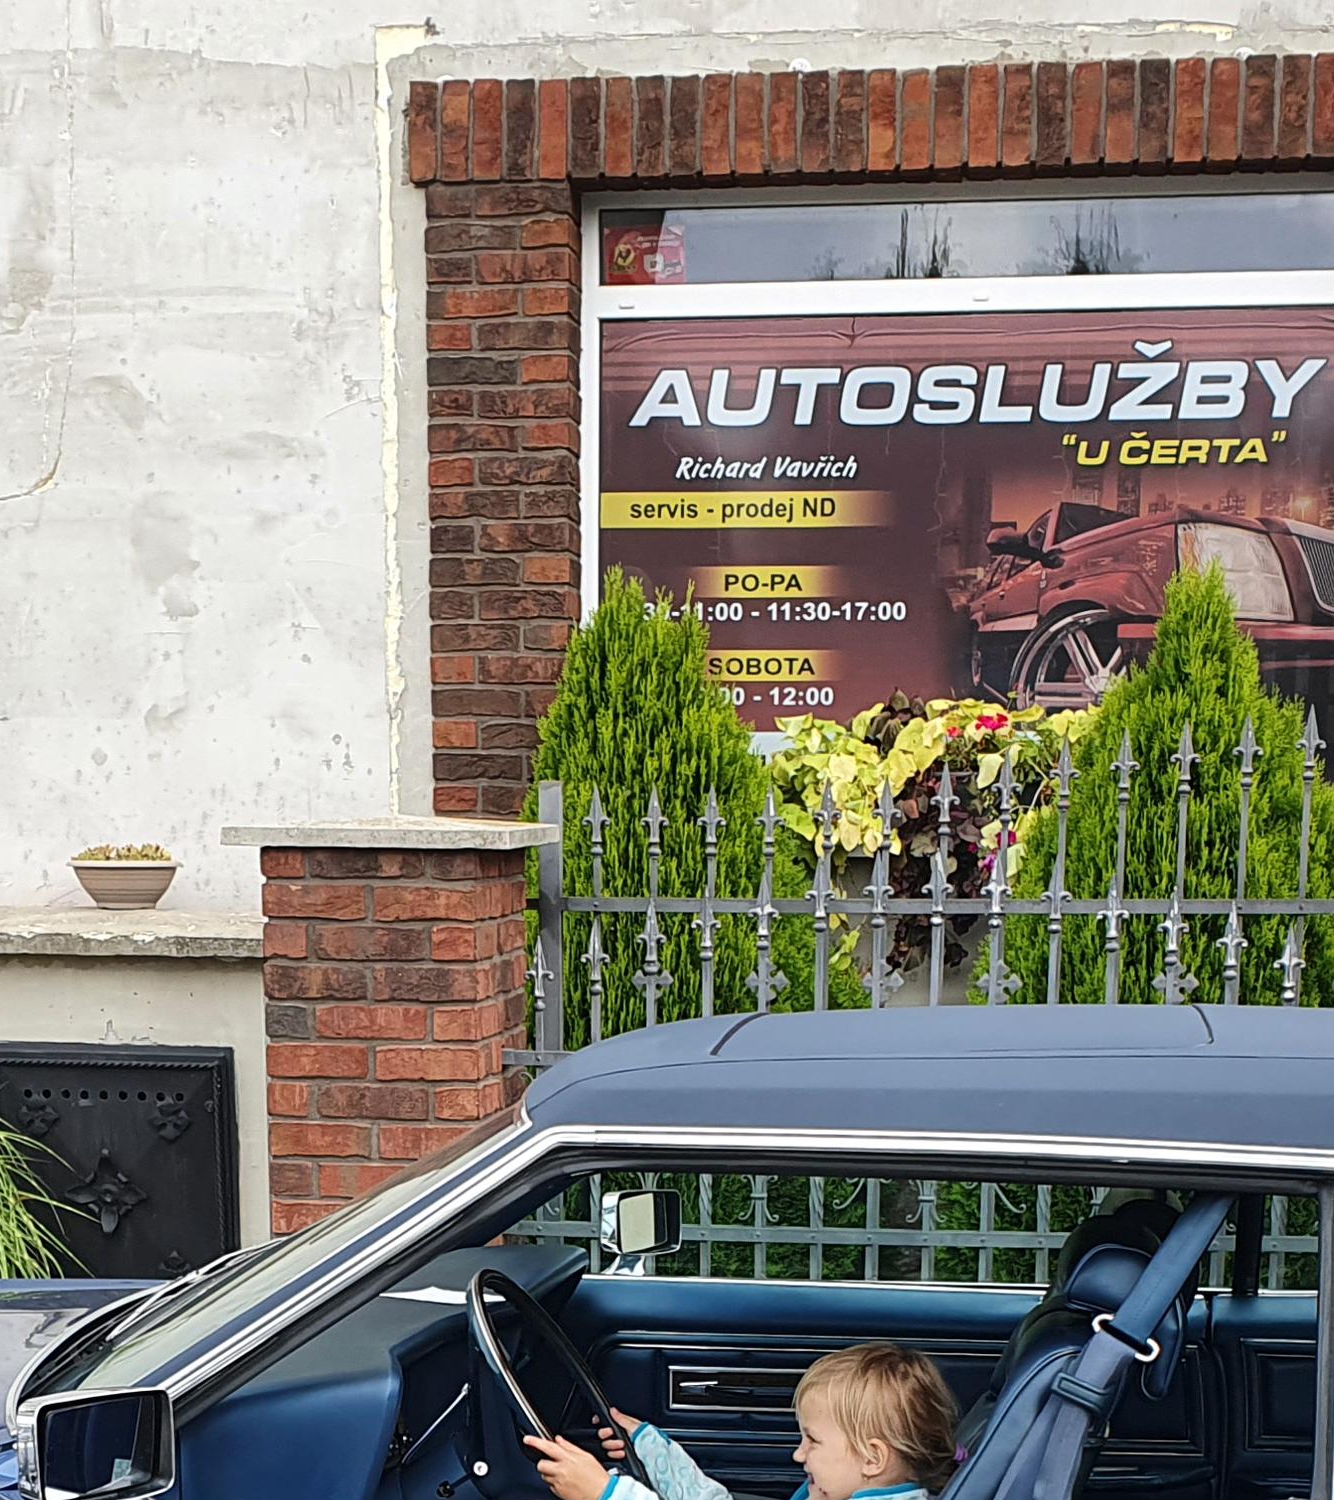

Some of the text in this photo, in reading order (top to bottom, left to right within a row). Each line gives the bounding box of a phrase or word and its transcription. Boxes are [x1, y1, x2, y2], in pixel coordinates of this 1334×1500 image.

[628, 340, 1328, 427] AUTOSLUŽBY
[675, 455, 858, 480] Richard Vavřich
[630, 499, 698, 519] servis
[721, 498, 794, 523] prodej
[802, 497, 836, 518] ND
[724, 573, 803, 592] PO-PA
[767, 602, 907, 622] 11:30-17:00
[708, 657, 816, 676] SOBOTA
[769, 687, 834, 706] 12:00
